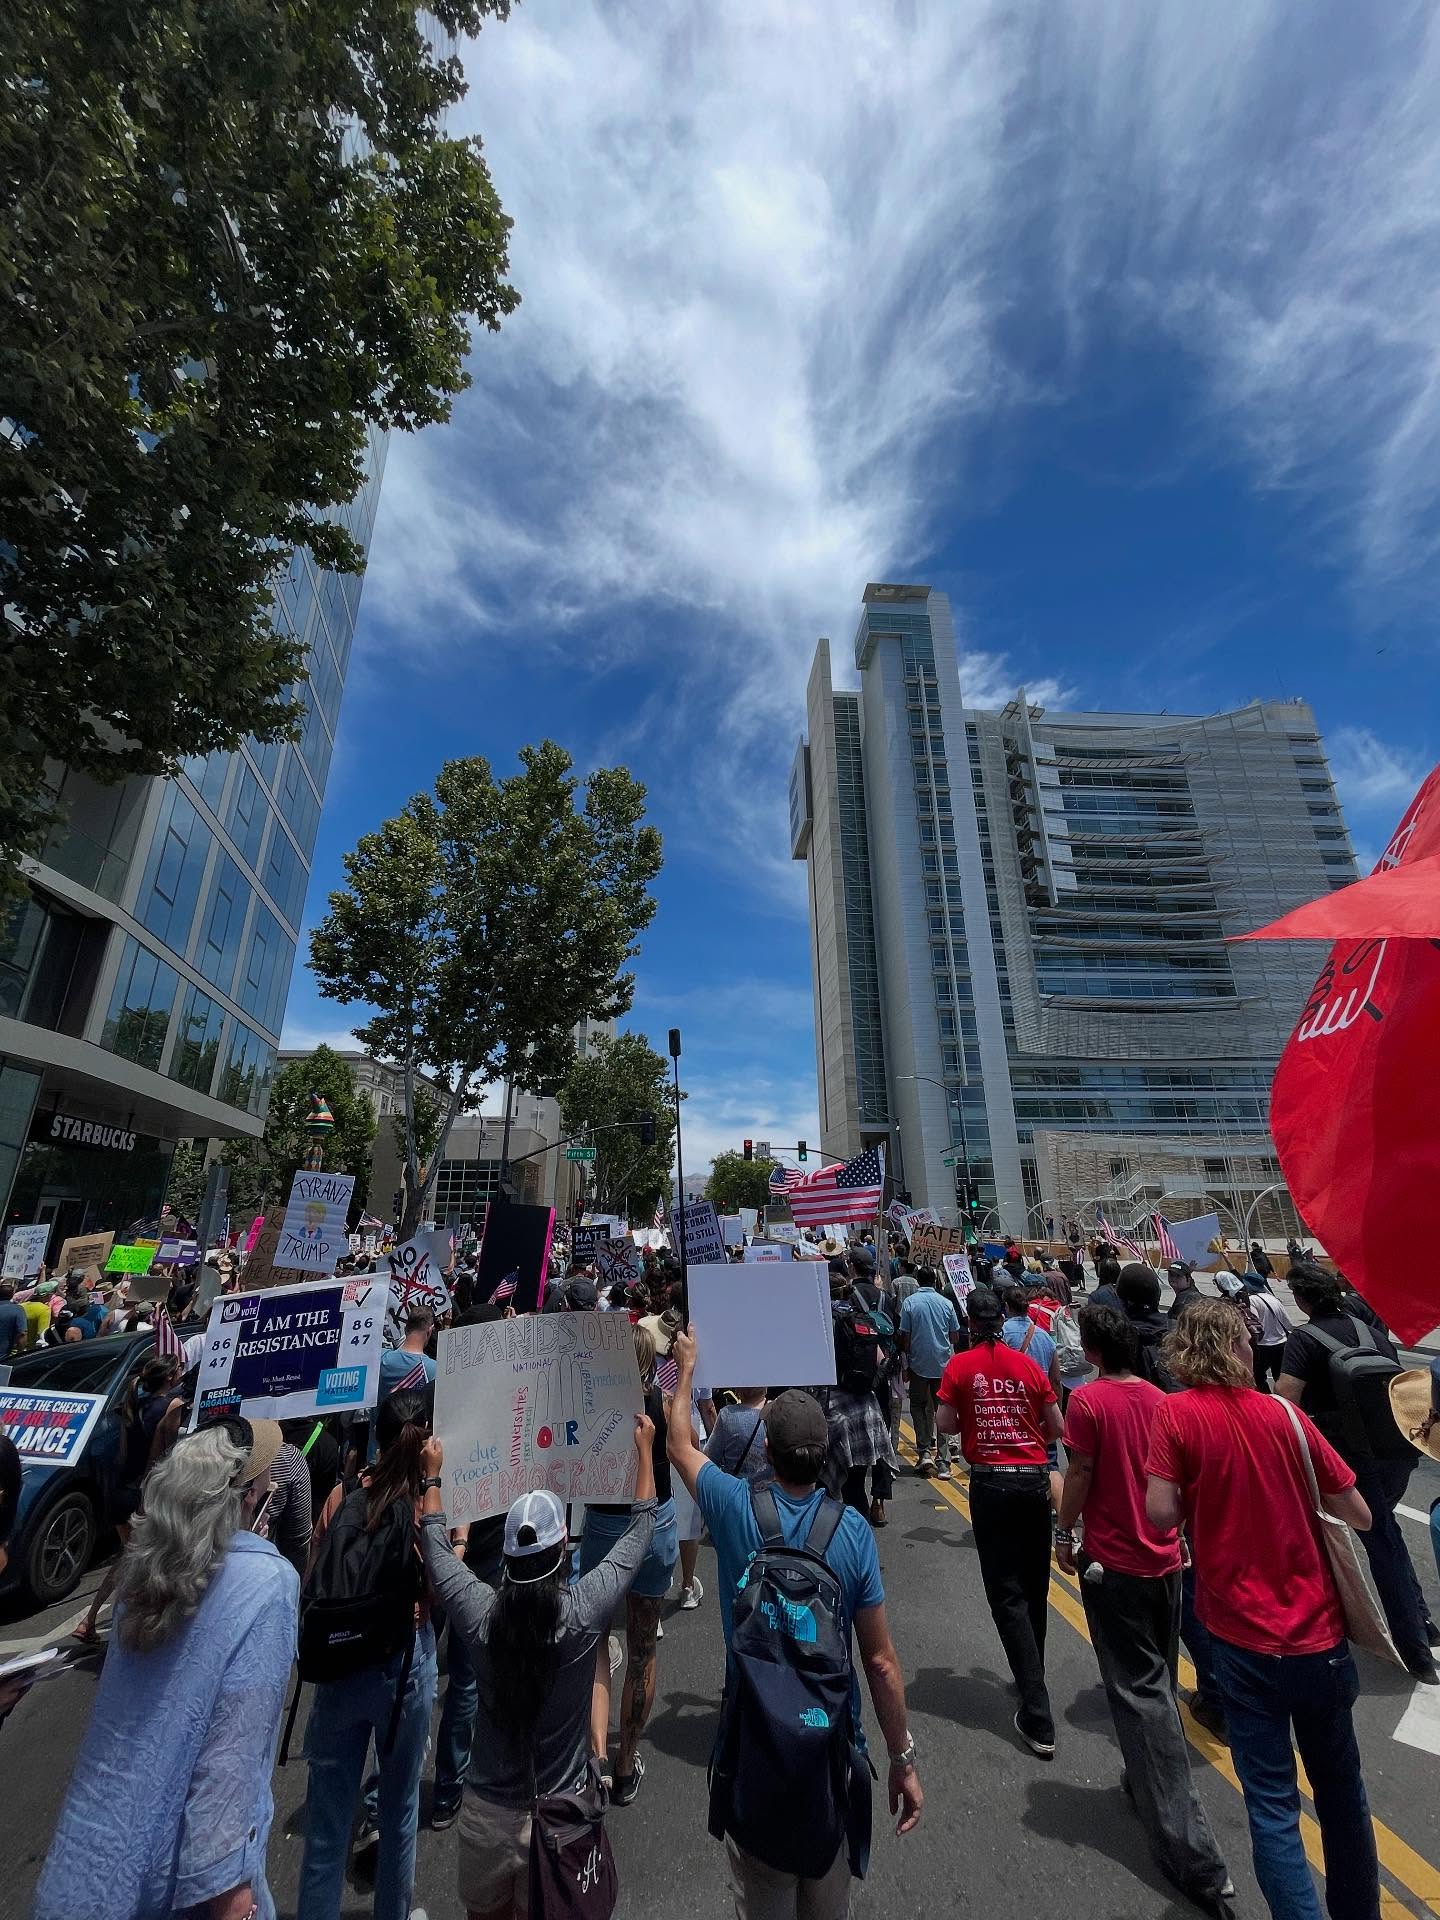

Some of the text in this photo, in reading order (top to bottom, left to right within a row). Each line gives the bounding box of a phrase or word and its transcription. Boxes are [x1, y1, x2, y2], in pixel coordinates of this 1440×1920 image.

[50, 1115, 137, 1151] STARBUCKS
[567, 1150, 595, 1158] Fifth St
[294, 1176, 352, 1205] TYRANT
[690, 1214, 712, 1228] DRAFT
[575, 1231, 607, 1243] HATE
[696, 1227, 717, 1240] STILL
[912, 1222, 960, 1243] HATE
[282, 1233, 330, 1262] TRUMP
[607, 1240, 624, 1249] NO
[913, 1245, 937, 1259] MAKE
[388, 1246, 417, 1275] NO
[603, 1264, 639, 1282] KINGS
[241, 1307, 257, 1317] VOTE
[251, 1310, 330, 1335] I AM THE
[236, 1329, 340, 1358] RESISTANCE!
[446, 1312, 628, 1375] HANDS OFF
[512, 1357, 553, 1373] NATIONAL
[326, 1371, 360, 1389] VOTING
[992, 1378, 1027, 1395] DSA
[207, 1387, 236, 1400] RESIST
[0, 1396, 90, 1414] WE ARE THE CHECKS
[200, 1395, 242, 1409] ORGANIZE
[207, 1405, 230, 1414] VOTE
[974, 1403, 1028, 1415] Democratic
[976, 1414, 1020, 1428] Socialists
[536, 1420, 580, 1448] OUR
[977, 1429, 1029, 1440] of America
[469, 1440, 499, 1463] due
[452, 1449, 640, 1518] DEMOCRACY
[799, 1713, 820, 1721] NORTH
